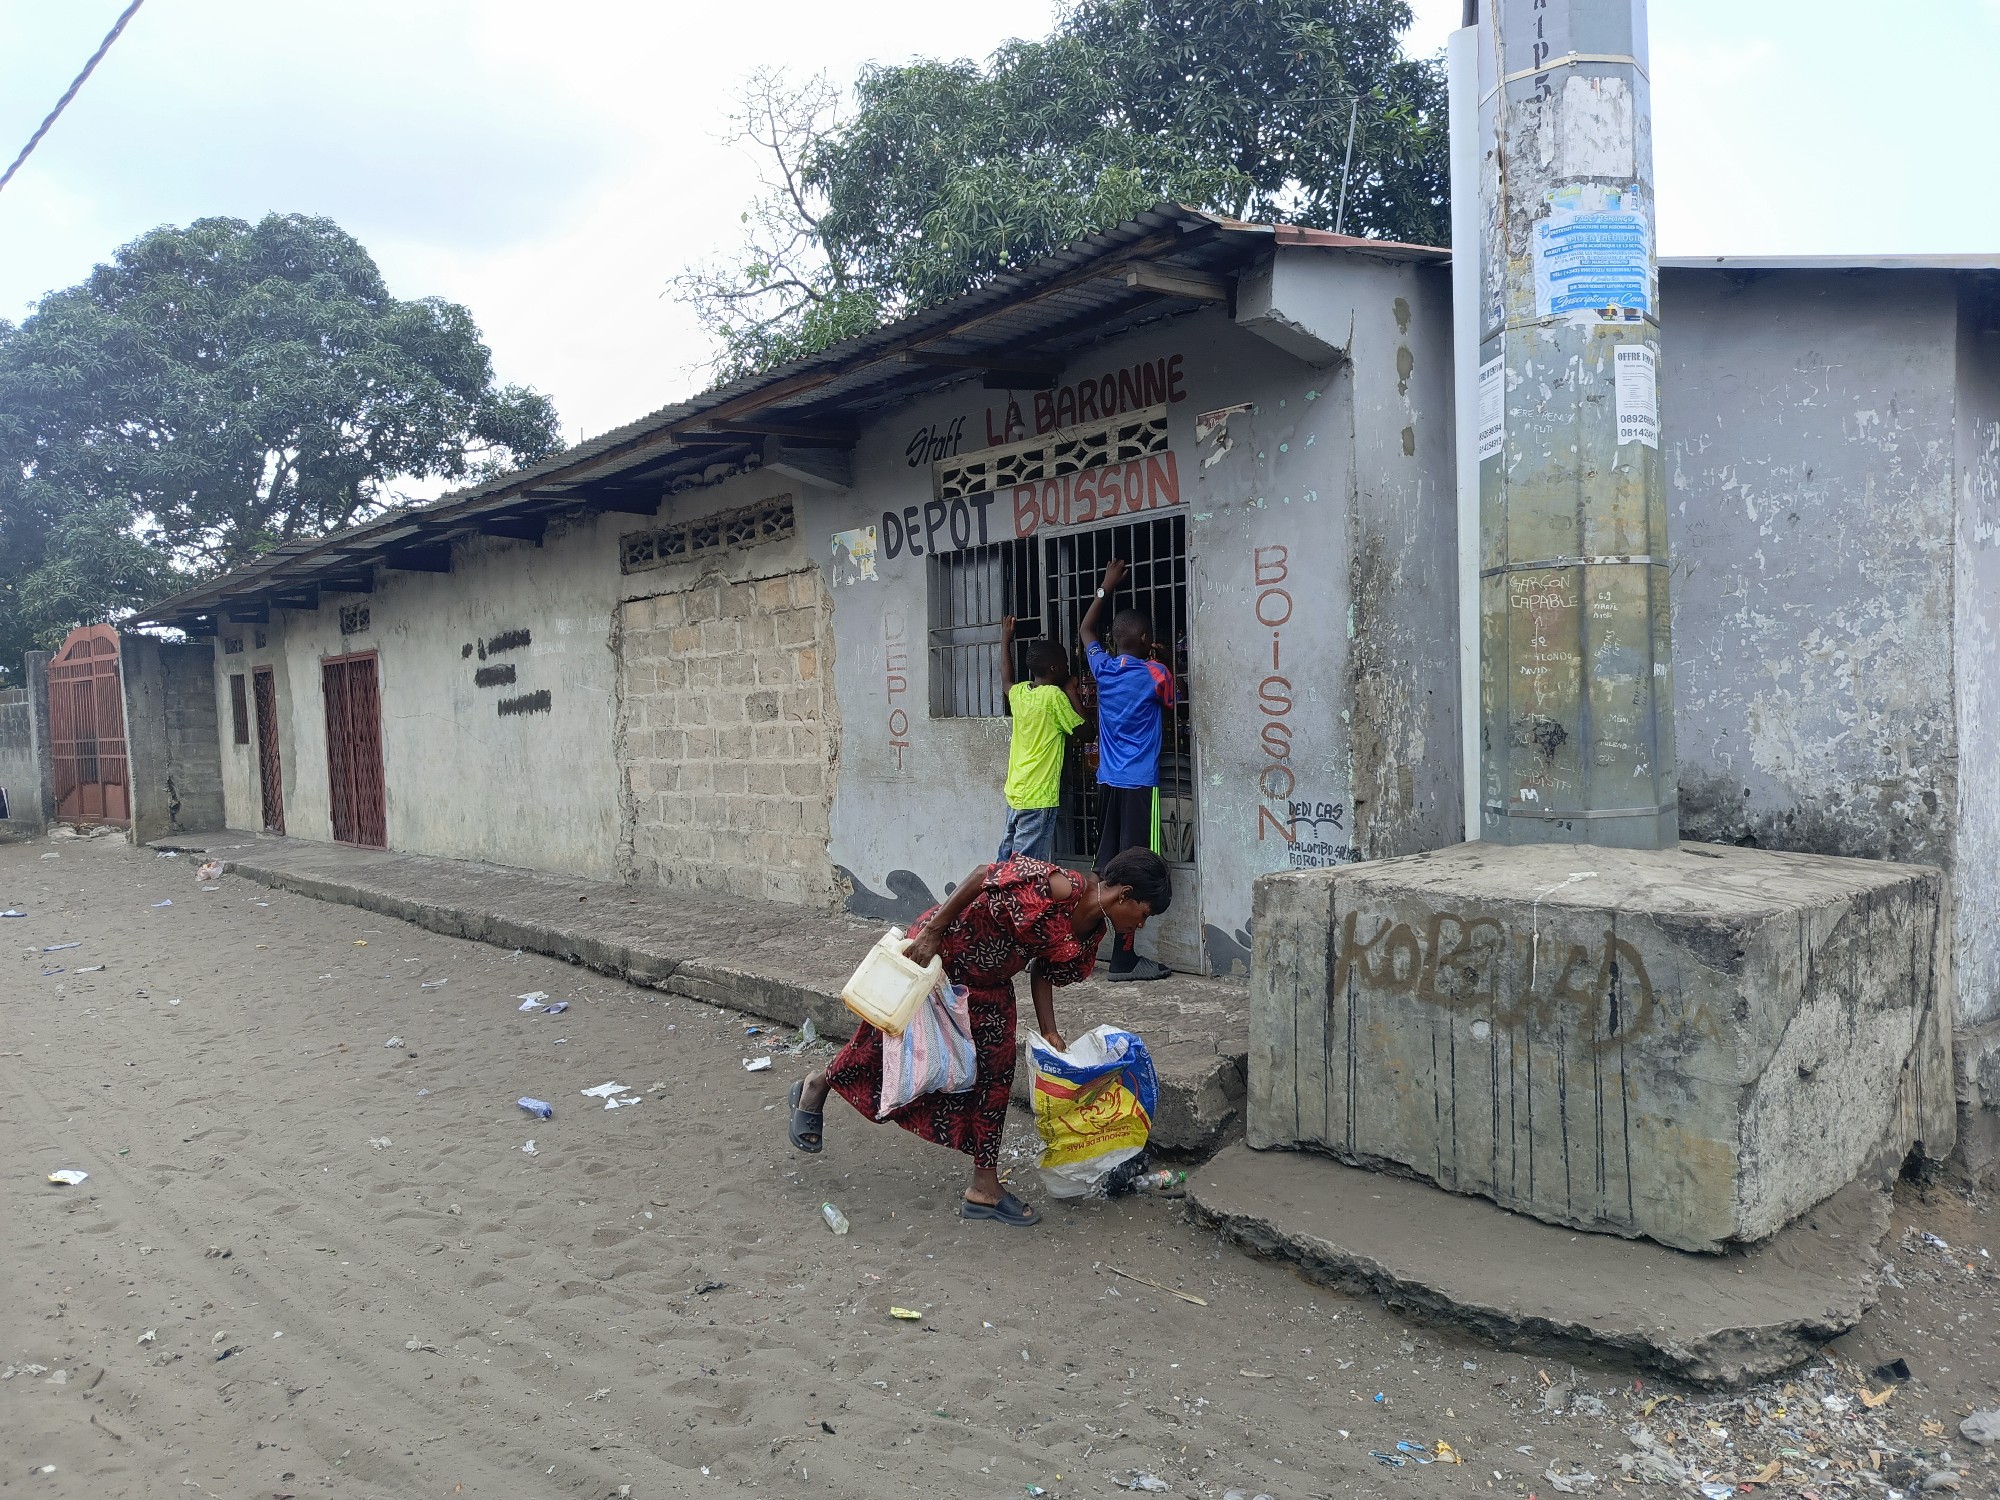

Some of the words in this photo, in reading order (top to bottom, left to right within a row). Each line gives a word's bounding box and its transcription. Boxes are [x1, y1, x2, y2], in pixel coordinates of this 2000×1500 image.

[1553, 294, 1608, 311] Inscription
[1617, 352, 1641, 362] OFFRE
[986, 401, 1024, 447] LA
[1034, 353, 1187, 435] BARONNE
[882, 491, 995, 560] DEPOT
[1012, 450, 1180, 538] BOISSON
[1511, 593, 1578, 612] CAPABLE
